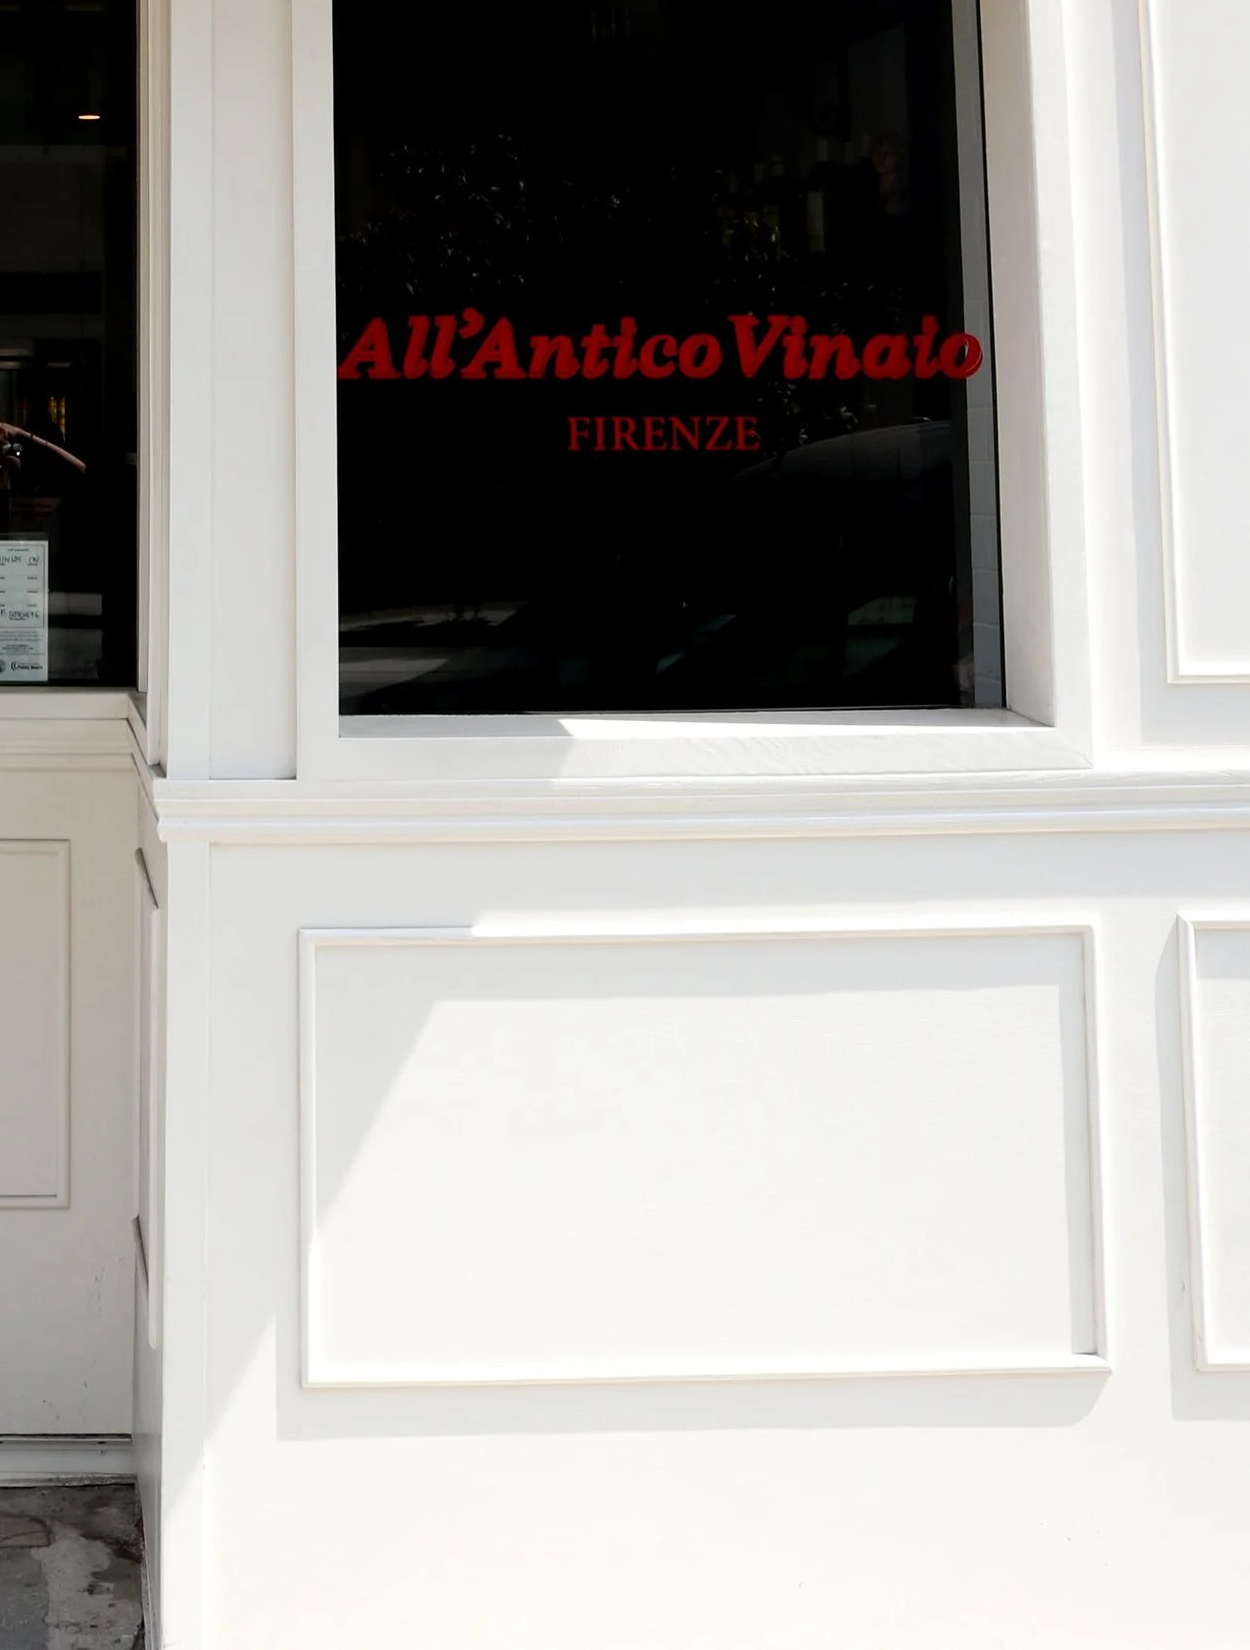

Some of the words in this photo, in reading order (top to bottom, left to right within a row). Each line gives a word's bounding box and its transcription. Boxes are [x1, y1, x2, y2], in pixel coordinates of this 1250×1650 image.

[337, 307, 723, 380] All'Antico
[727, 314, 984, 380] Vinaio
[567, 416, 760, 451] FIRENZE
